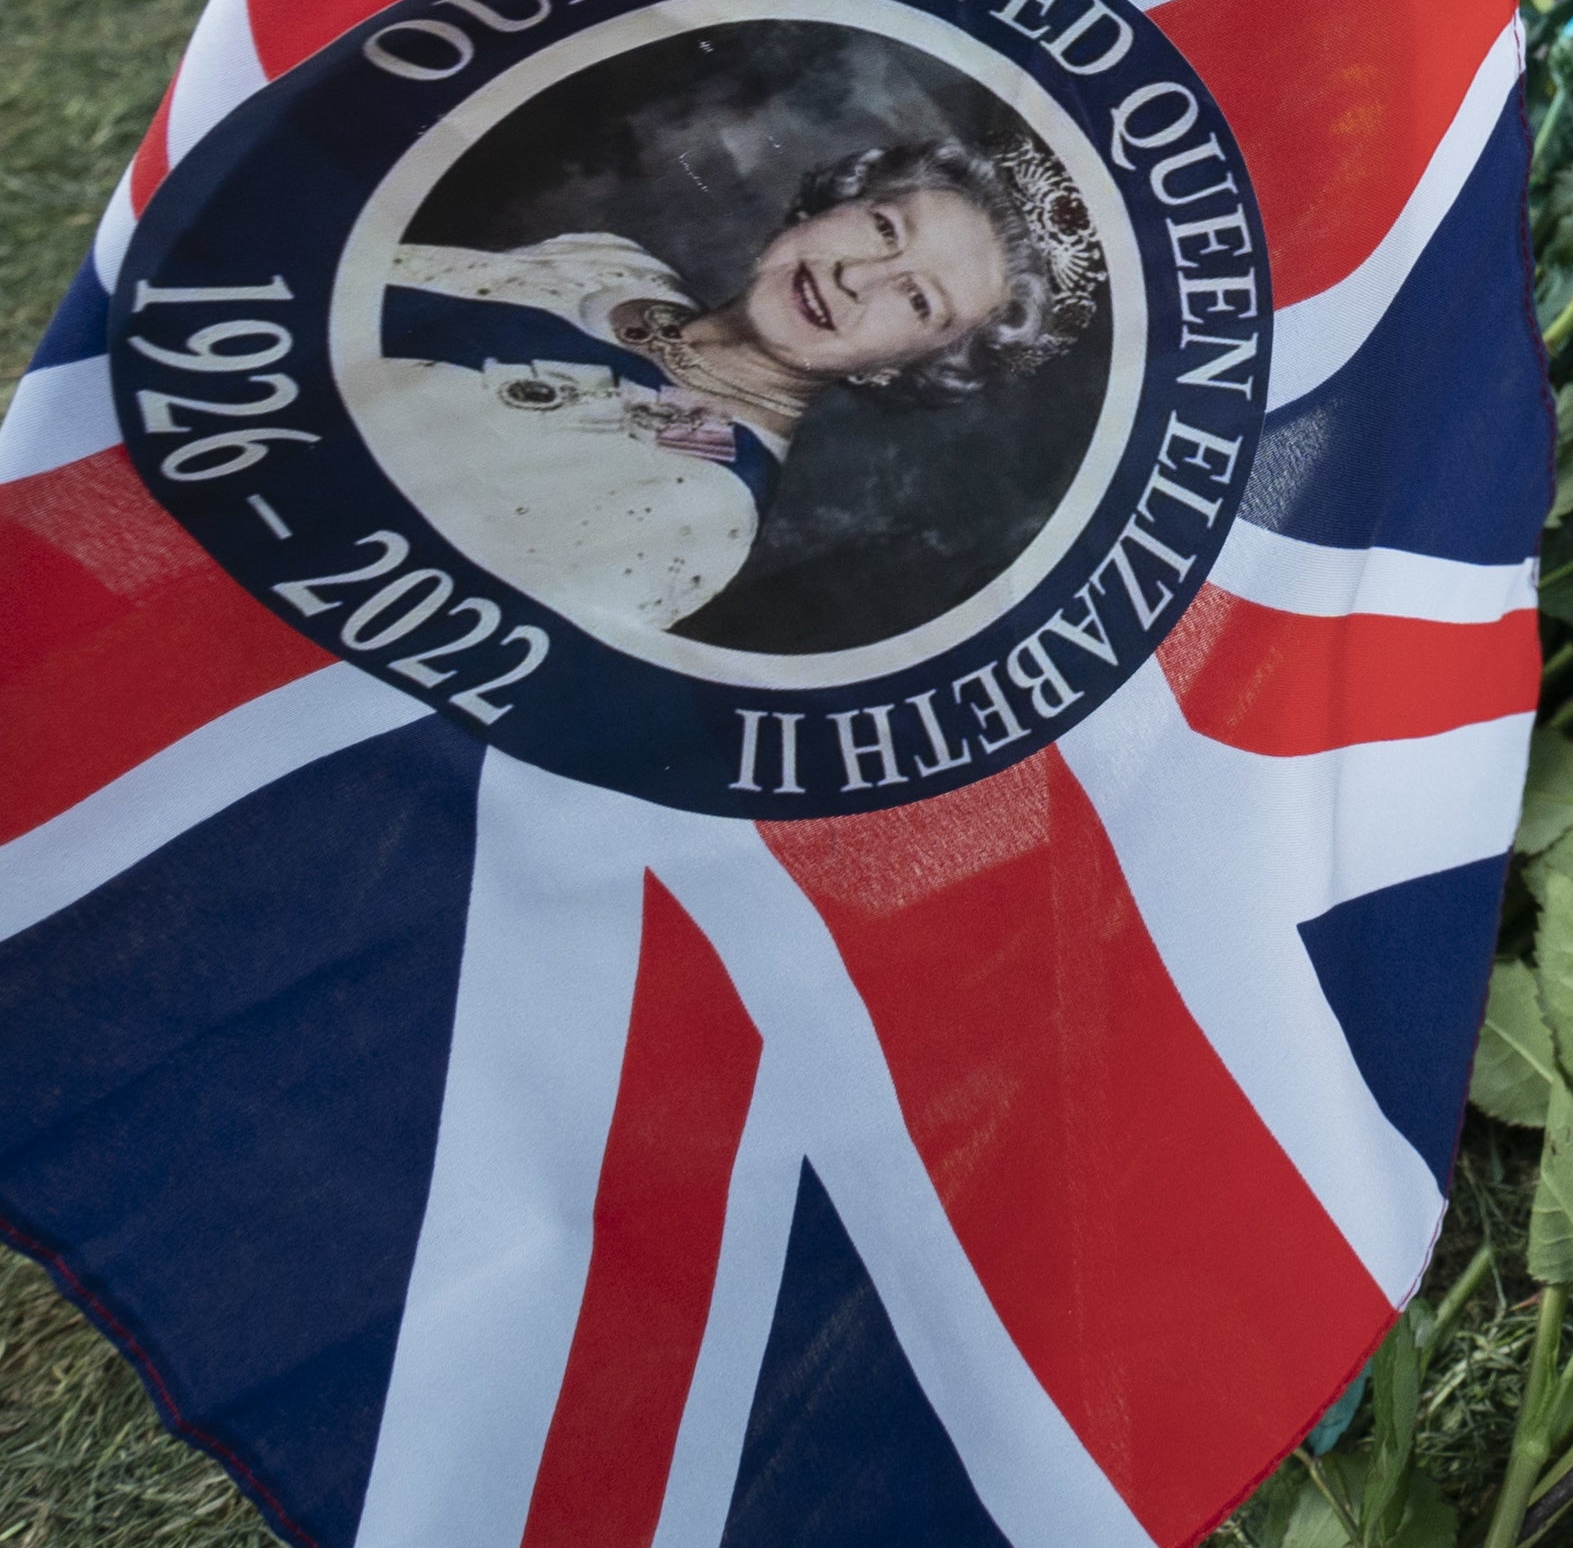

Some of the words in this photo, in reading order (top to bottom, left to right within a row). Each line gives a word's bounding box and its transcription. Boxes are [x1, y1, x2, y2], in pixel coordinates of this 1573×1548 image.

[1109, 81, 1260, 403] QUEEN
[126, 274, 323, 482] 1926
[269, 528, 551, 726] 2022
[826, 409, 1245, 793] ELIZABETH
[727, 708, 806, 794] II
